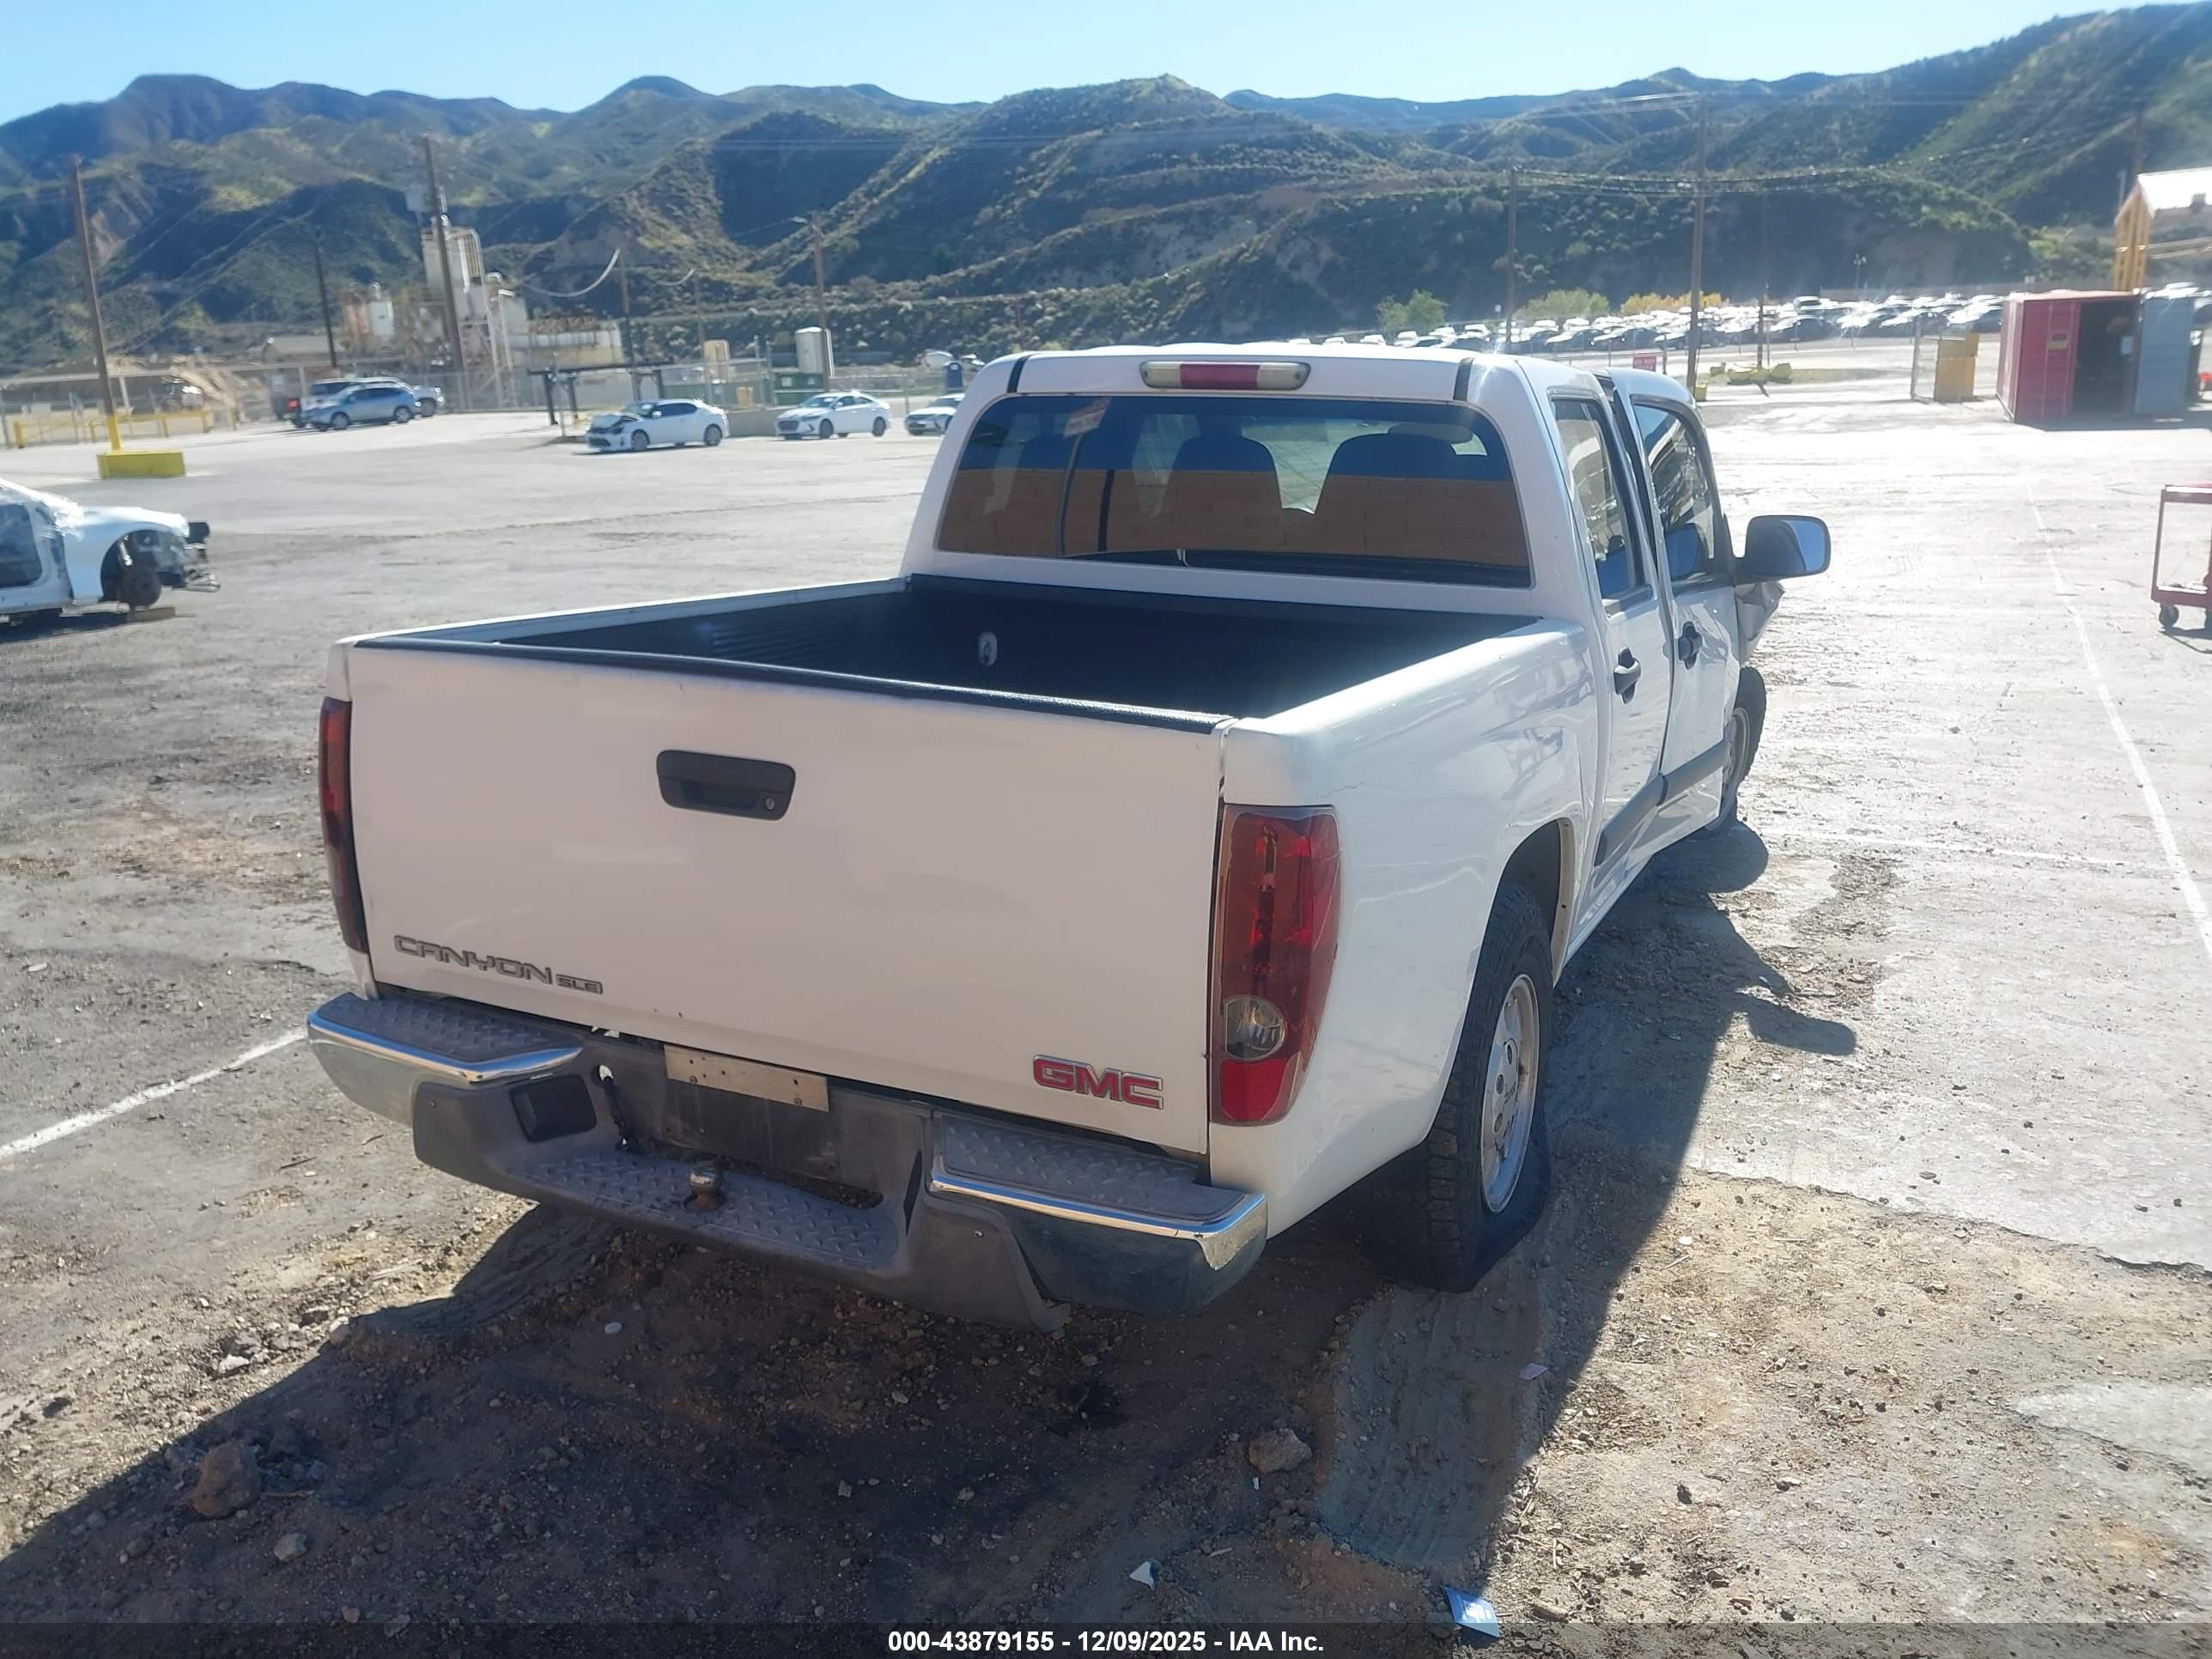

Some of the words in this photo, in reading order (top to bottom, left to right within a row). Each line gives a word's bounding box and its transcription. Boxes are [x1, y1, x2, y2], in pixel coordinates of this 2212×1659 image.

[394, 935, 553, 985] CANYON
[556, 974, 603, 994] SLE
[1033, 1054, 1164, 1109] GMC
